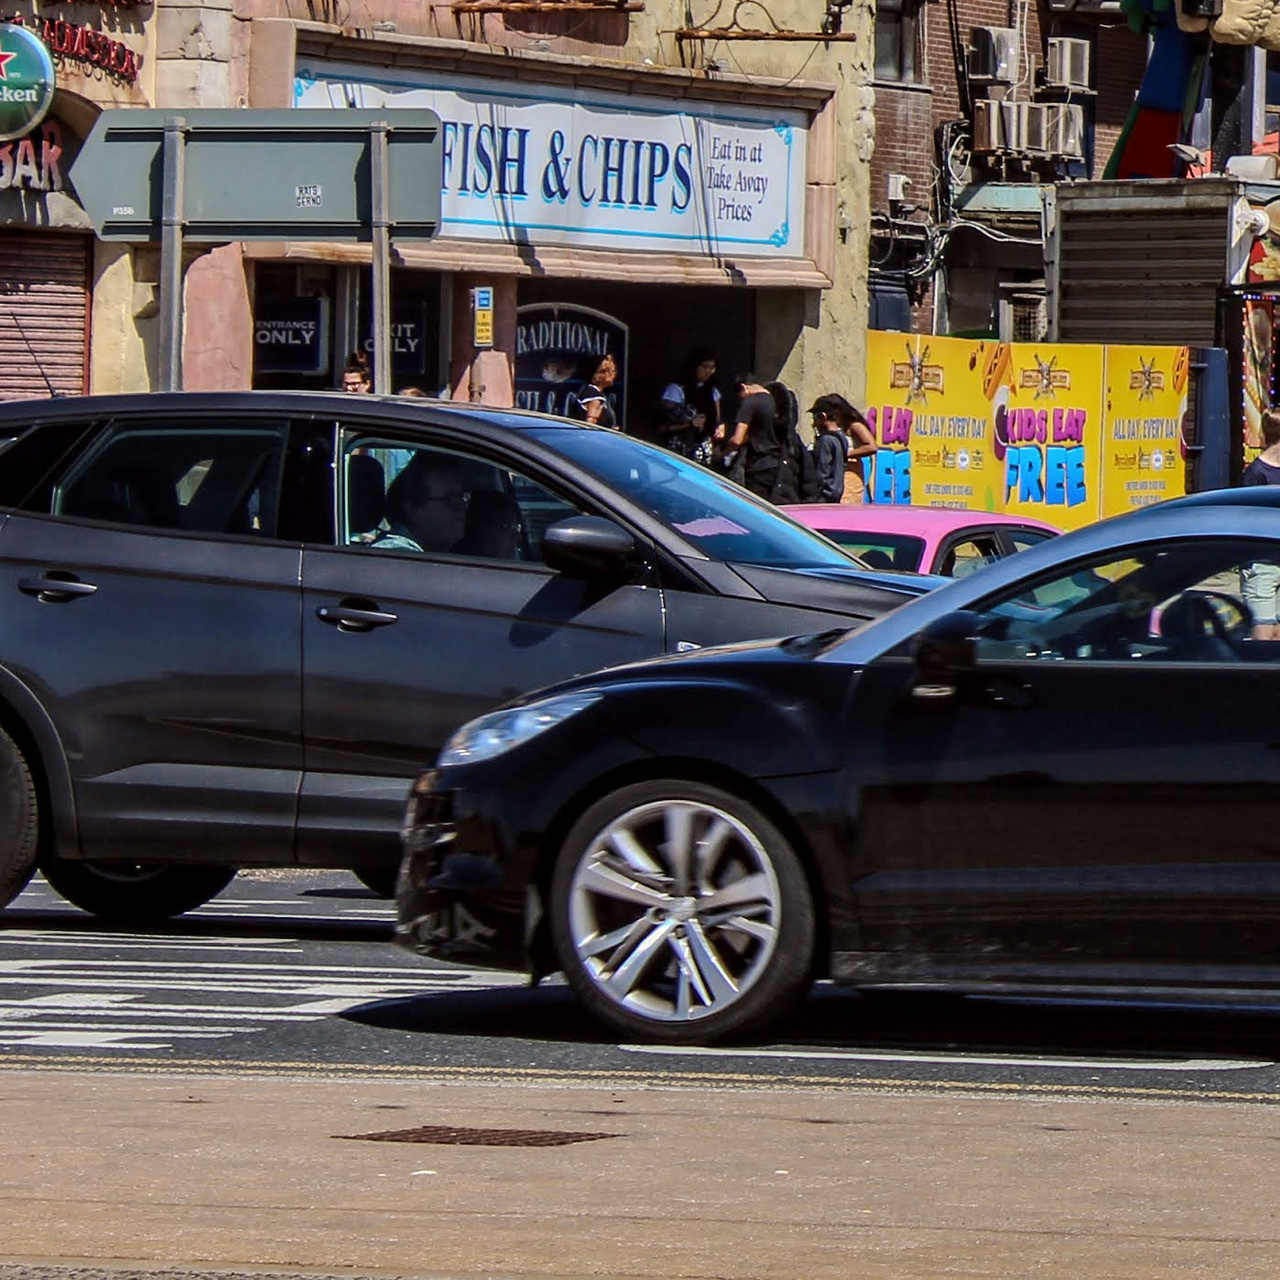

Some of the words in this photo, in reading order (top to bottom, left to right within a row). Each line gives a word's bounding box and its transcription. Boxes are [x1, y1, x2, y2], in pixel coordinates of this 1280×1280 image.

[711, 137, 732, 162] Eat
[735, 138, 748, 161] in
[751, 140, 763, 163] at
[441, 122, 531, 200] FISH
[542, 130, 572, 204] &
[577, 134, 693, 214] CHIPS
[707, 166, 731, 191] Take
[735, 171, 768, 204] Away
[717, 197, 752, 222] Prices
[256, 321, 316, 330] ENTRANCE
[256, 330, 316, 345] ONLY
[517, 321, 608, 355] RADITIONAL
[364, 339, 419, 352] OLY
[882, 406, 913, 447] EAT
[948, 417, 971, 438] EVERY
[972, 418, 987, 439] DAY
[1007, 408, 1047, 444] KIDS
[1053, 408, 1087, 444] EAT
[1143, 419, 1165, 440] EVERY
[1005, 444, 1087, 507] FREE
